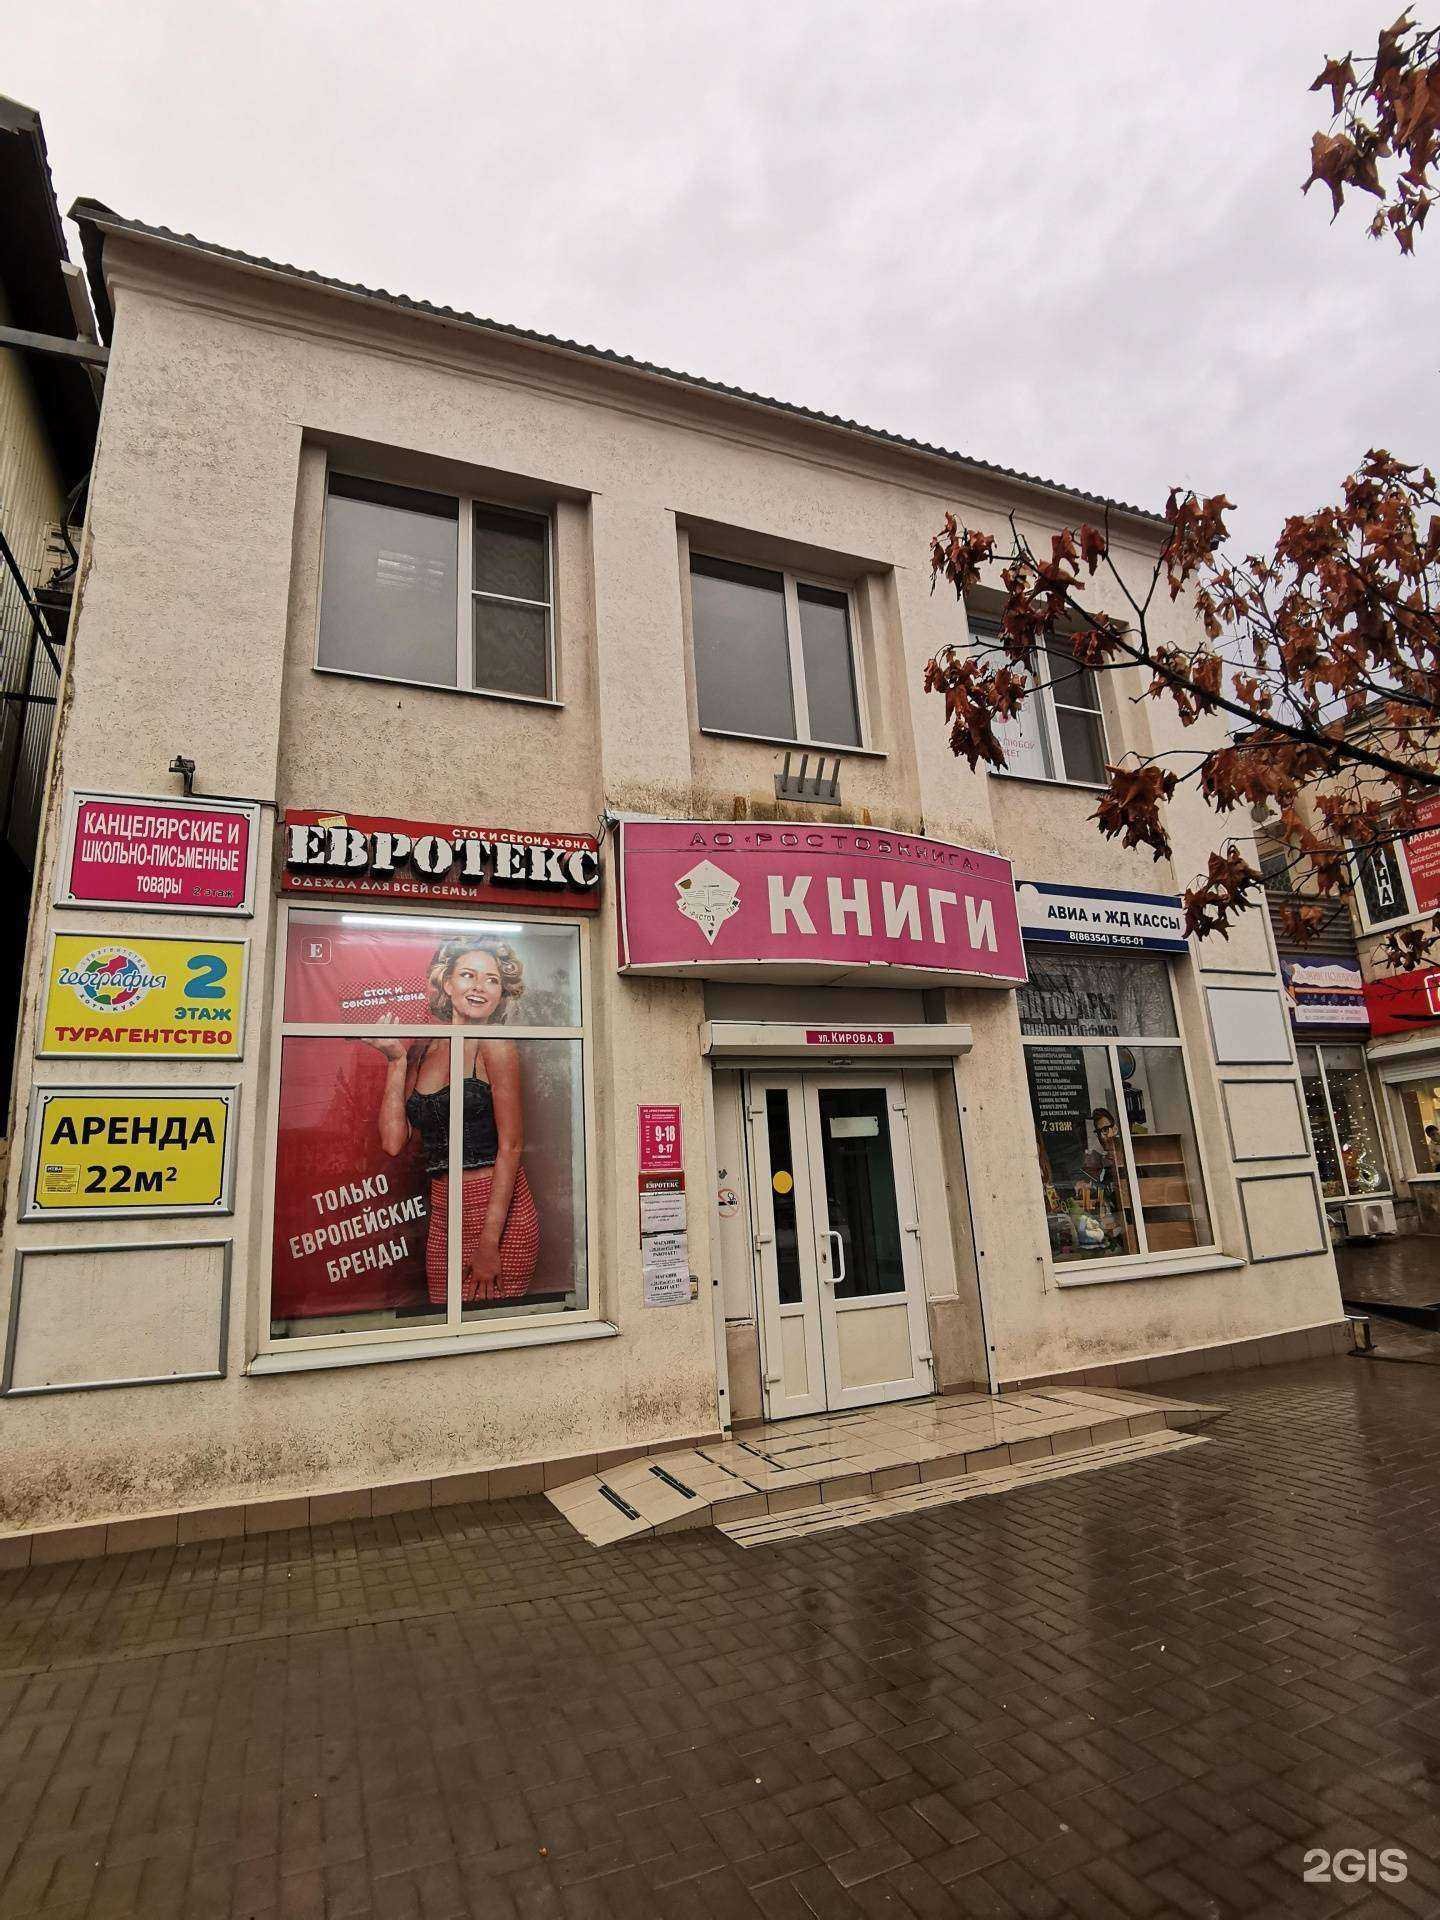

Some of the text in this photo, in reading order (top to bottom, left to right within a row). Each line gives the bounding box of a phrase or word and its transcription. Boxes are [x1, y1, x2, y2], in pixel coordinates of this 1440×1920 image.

[84, 811, 239, 844] КАНЦЕЛЯРСКИЕ И
[452, 829, 487, 840] СТОК
[81, 840, 239, 872] ШКОЛЬНО-ПИСЬМЕННЫЕ
[286, 824, 599, 886] ЕВРОТЕКС
[193, 886, 201, 896] 2
[291, 876, 478, 897] ОДЕЖДА ДЛЯ ВСЕЙ СЕМЬИ
[767, 875, 998, 953] КНИГИ
[1047, 905, 1088, 922] АВИА
[1105, 910, 1131, 928] ЖД
[1134, 913, 1181, 930] КАССЫ
[1112, 935, 1144, 946] 5-65-01
[184, 954, 228, 1000] 2
[364, 987, 393, 997] СТОК
[174, 1006, 232, 1021] ЭТАЖ
[55, 1026, 233, 1045] ТУРАГЕНТСТВО
[50, 1116, 216, 1150] АРЕНДА
[312, 1173, 389, 1215] ТОЛЬКО
[288, 1195, 427, 1259] ЕВРОПЕЙСКИЕ
[326, 1236, 409, 1283] БРЕНДЫ
